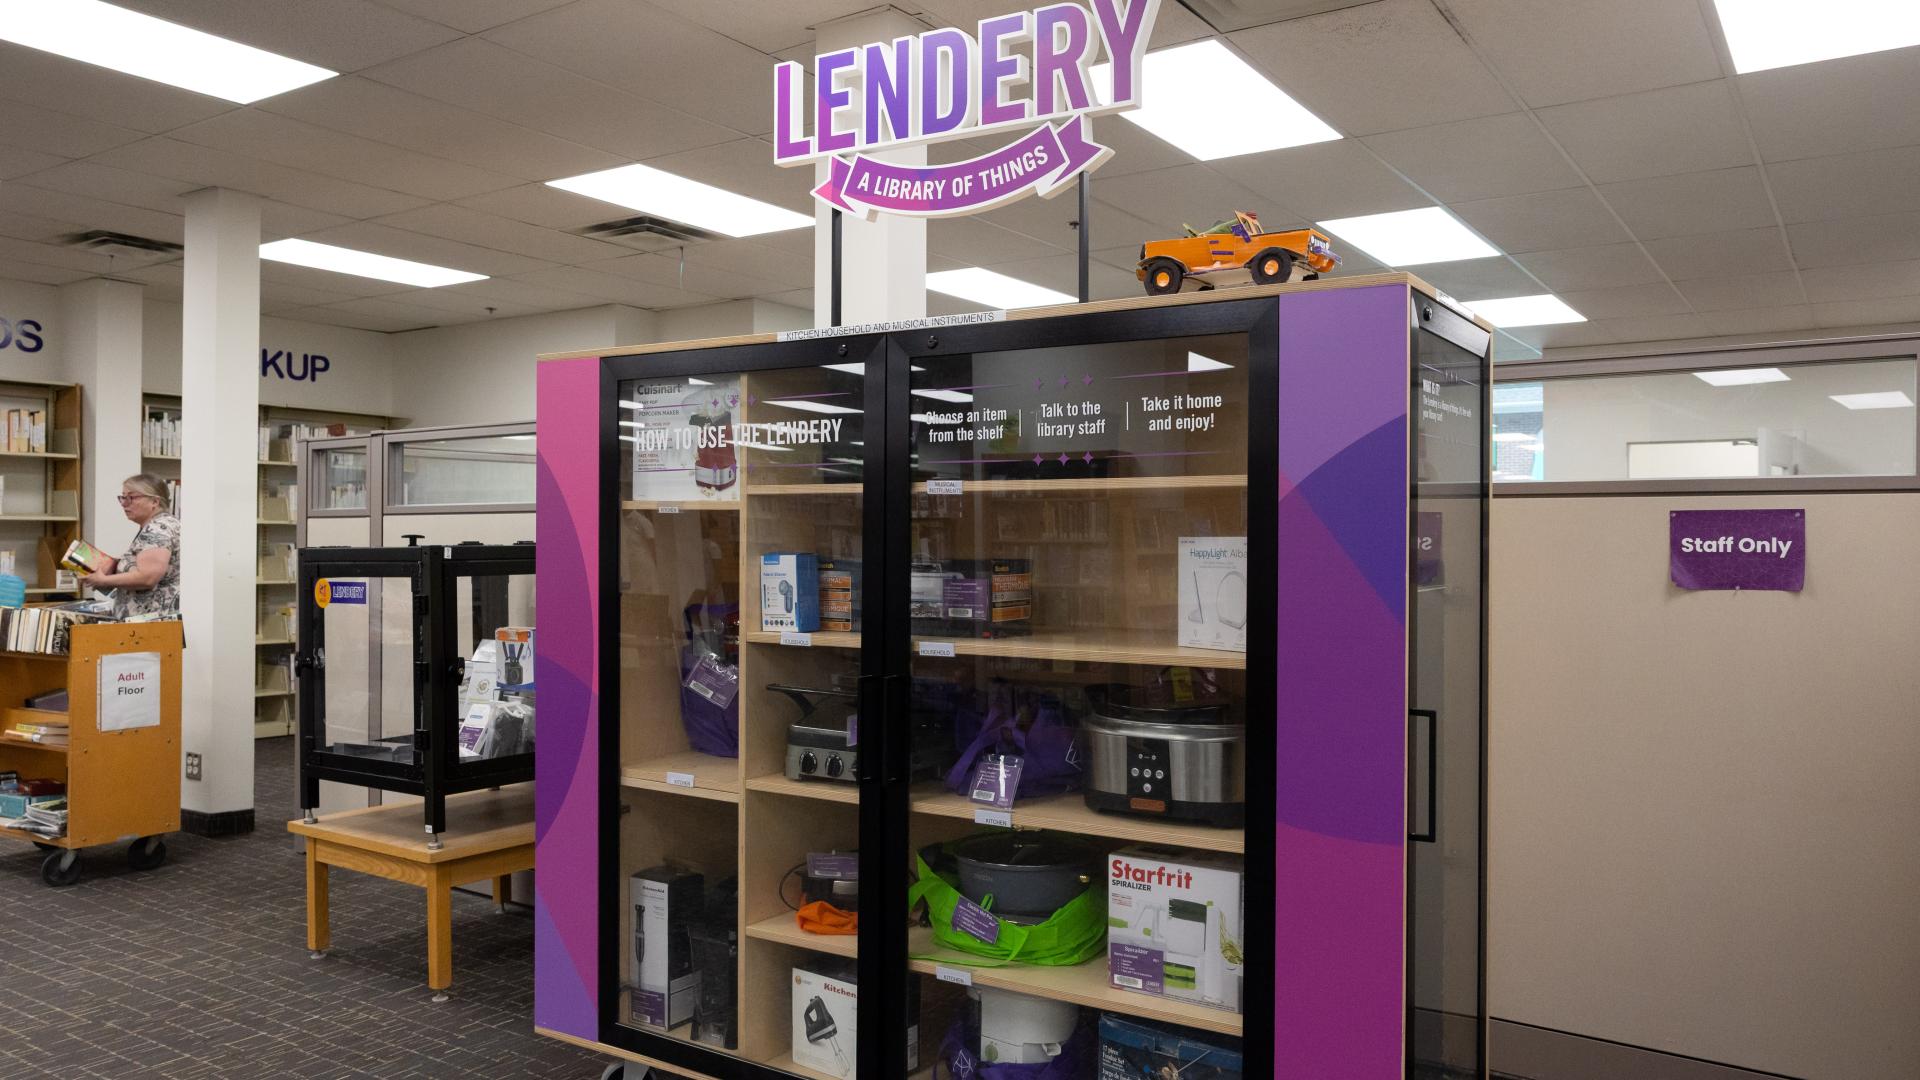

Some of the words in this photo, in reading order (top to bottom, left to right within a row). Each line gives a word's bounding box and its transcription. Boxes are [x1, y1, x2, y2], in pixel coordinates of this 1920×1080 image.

[774, 0, 1160, 162] LENDERY
[857, 172, 869, 191] A
[873, 175, 944, 200] LIBRARY
[951, 175, 974, 198] OF
[978, 145, 1049, 191] THINGS
[786, 329, 820, 341] KITCHEN
[821, 323, 871, 337] HOUSEHOLD
[873, 321, 891, 331] AND
[892, 318, 929, 330] MUSICAL
[931, 312, 995, 326] INSTRUMENTS
[637, 383, 682, 396] Cuisinart
[1040, 403, 1064, 418] Talk
[1067, 404, 1078, 417] to
[1081, 402, 1101, 415] the
[1142, 396, 1172, 412] Take
[1174, 395, 1183, 410] it
[1186, 395, 1222, 409] home
[926, 410, 963, 426] Choose
[966, 412, 981, 424] an
[983, 409, 1007, 422] item
[1149, 416, 1171, 431] and
[1175, 413, 1215, 432] enjoy!
[636, 428, 669, 452] HOW
[674, 427, 692, 450] TO
[698, 425, 727, 449] USE
[733, 423, 761, 447] THE
[767, 418, 843, 446] LENDERY
[929, 428, 954, 443] from
[956, 427, 974, 442] the
[977, 425, 1004, 440] shelf
[1037, 421, 1074, 438] library
[1078, 419, 1106, 435] staff
[1190, 548, 1227, 559] HappyLight
[1681, 536, 1734, 553] Staff
[1738, 537, 1793, 559] Only
[920, 648, 951, 656] HOUSEHOLD
[118, 672, 144, 681] Adult
[118, 687, 144, 695] Floor
[985, 818, 1007, 826] KITCHEN
[1111, 859, 1193, 889] Starfrit
[1111, 879, 1152, 892] SPIRALIZER
[943, 974, 965, 983] KITCHEN
[823, 982, 857, 998] Kitchen
